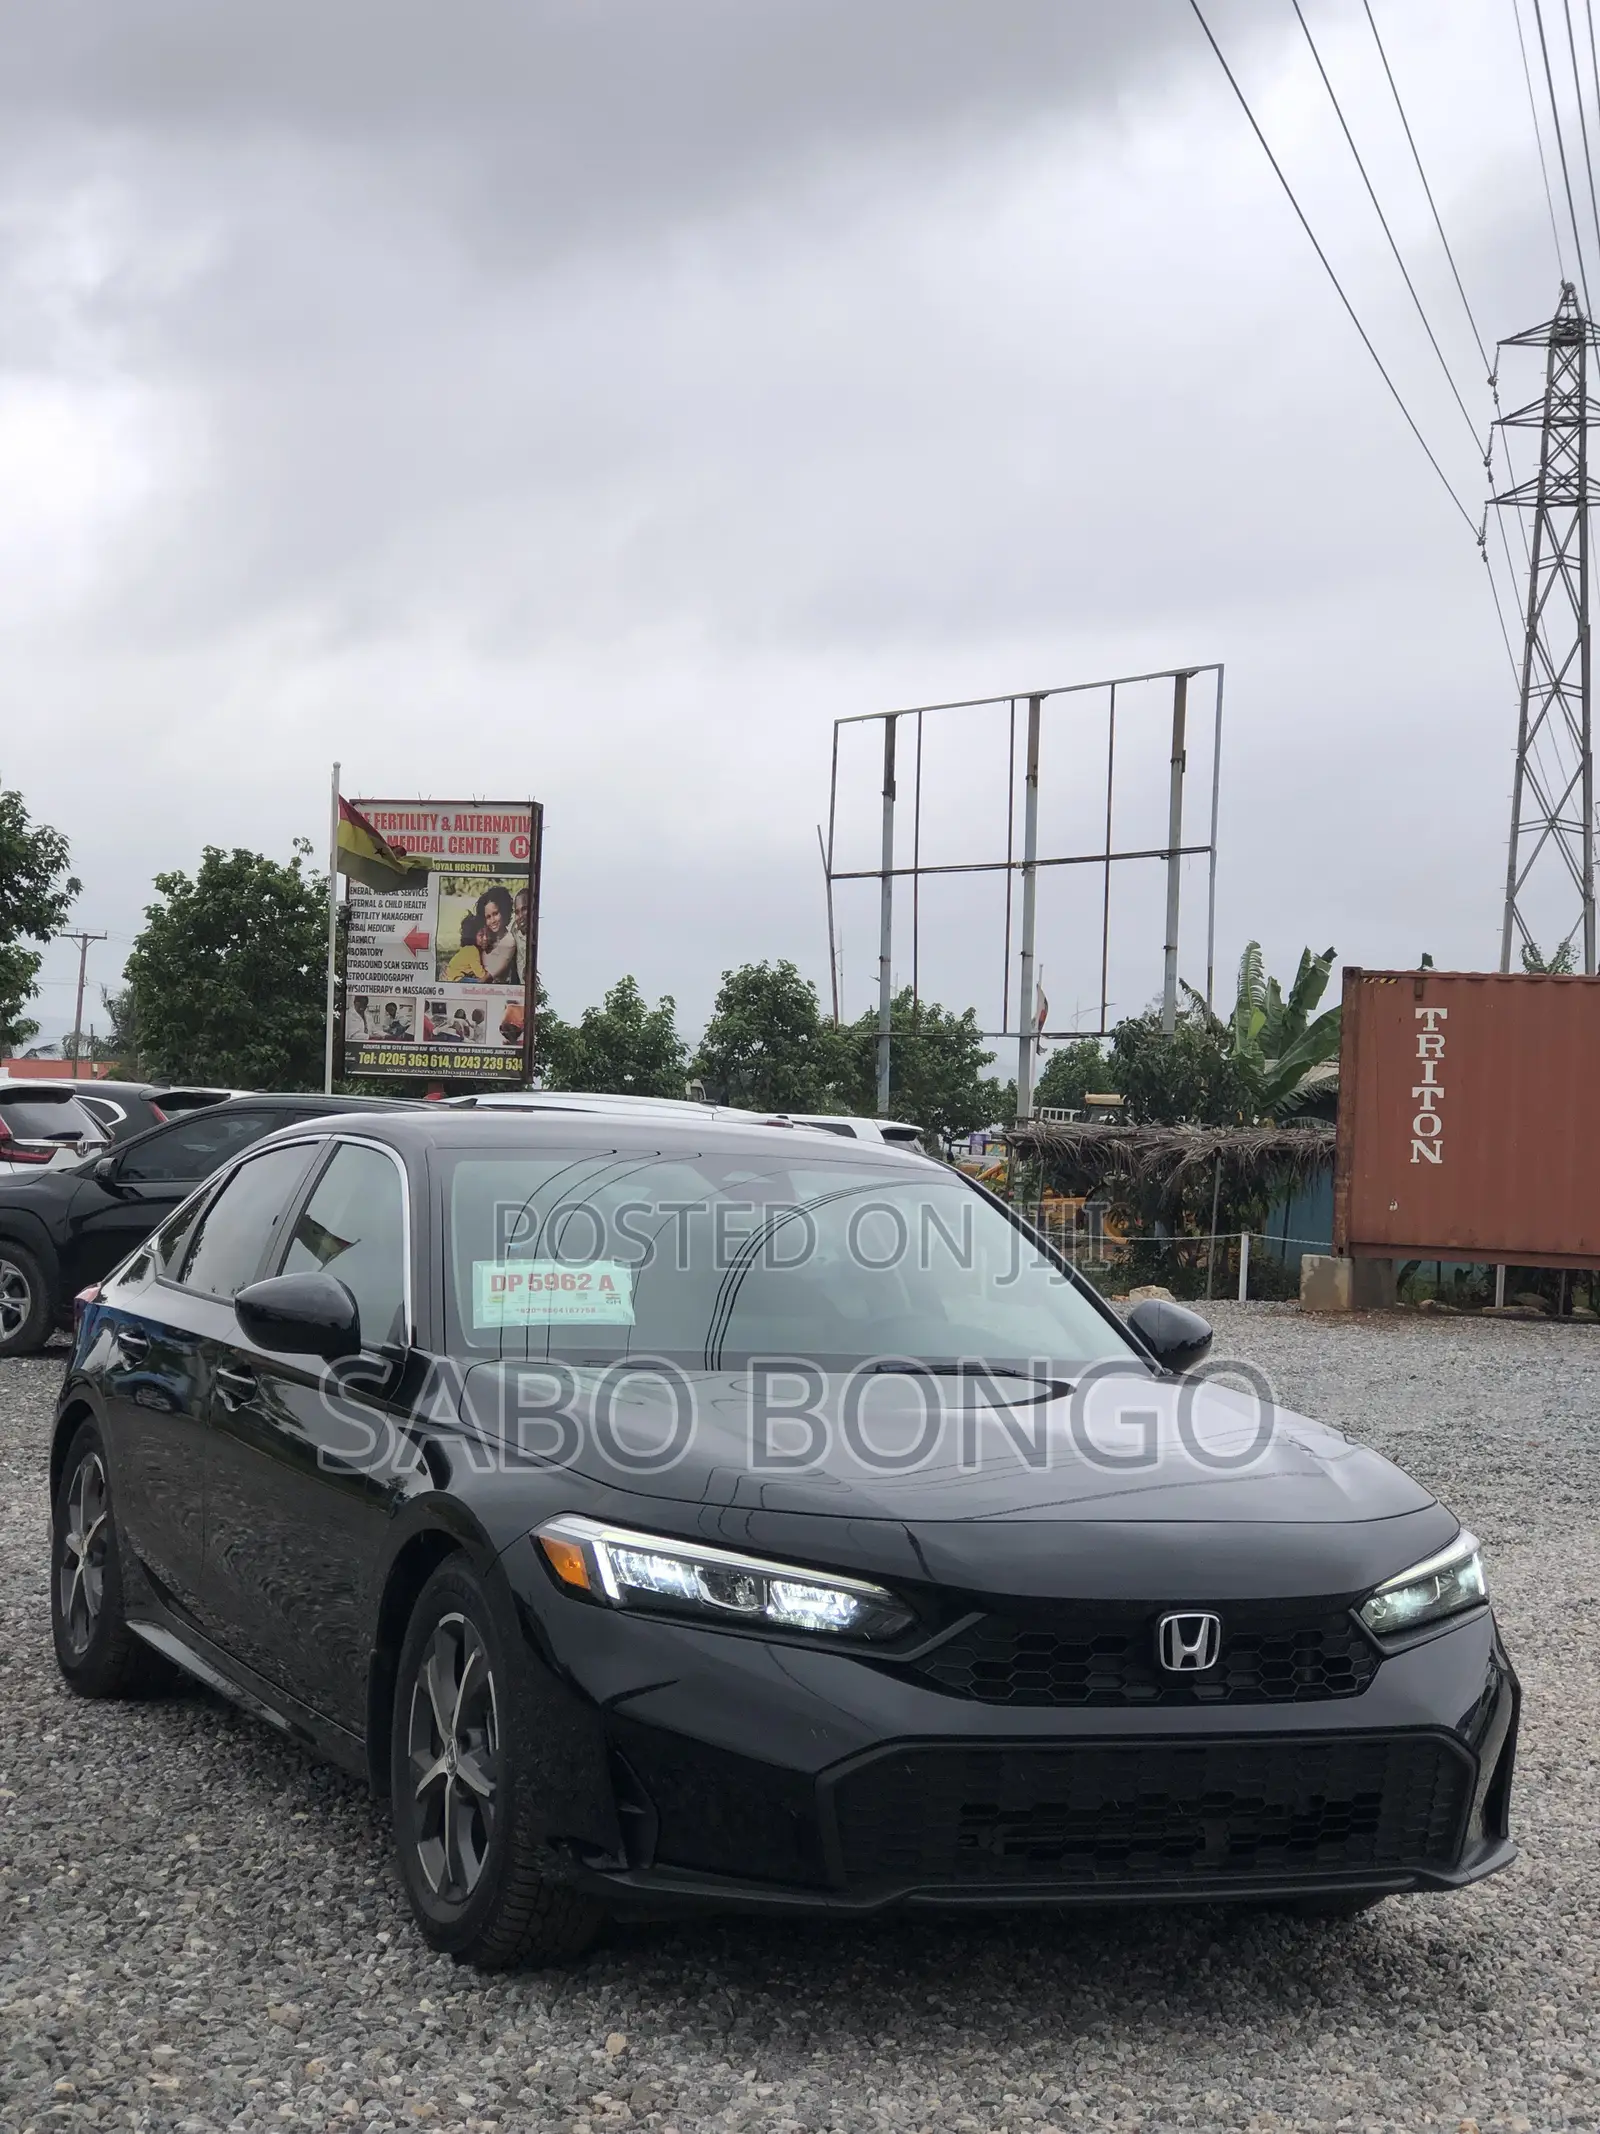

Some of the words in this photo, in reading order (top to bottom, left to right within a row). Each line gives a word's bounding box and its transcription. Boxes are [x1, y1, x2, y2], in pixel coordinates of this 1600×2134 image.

[374, 812, 438, 831] FERTILITY
[441, 816, 452, 831] &
[454, 814, 531, 833] ALTERNATIV
[387, 835, 445, 853] MEDICAL
[448, 836, 499, 855] CENTRE
[454, 862, 491, 872] HOSPITAL
[349, 886, 372, 896] ENERAL
[401, 888, 429, 898] SERVICES
[350, 898, 376, 908] ATERNAL
[377, 900, 383, 908] &
[384, 900, 403, 909] CHILD
[403, 900, 427, 910] HEALTH
[381, 912, 424, 922] MANAGEMENT
[348, 922, 366, 933] ERBAL
[367, 923, 396, 933] MEDICINE
[347, 935, 377, 945] HARMACY
[347, 947, 384, 957] ABORATORY
[347, 959, 383, 969] LTRASOUND
[383, 960, 401, 970] SCAN
[401, 961, 429, 971] SERVICES
[347, 983, 394, 994] HYSIOTHERAPY
[402, 985, 437, 996] MASSAGING
[358, 1051, 377, 1065] Tel:
[378, 1052, 407, 1067] 0205
[407, 1053, 429, 1068] 363
[453, 1055, 481, 1070] 0243
[482, 1056, 504, 1070] 239
[386, 1066, 499, 1077] www.zoeroyalhospital.com
[1410, 1007, 1448, 1164] TRITON
[490, 1274, 523, 1292] DP
[528, 1272, 594, 1292] 5962
[598, 1274, 616, 1291] A
